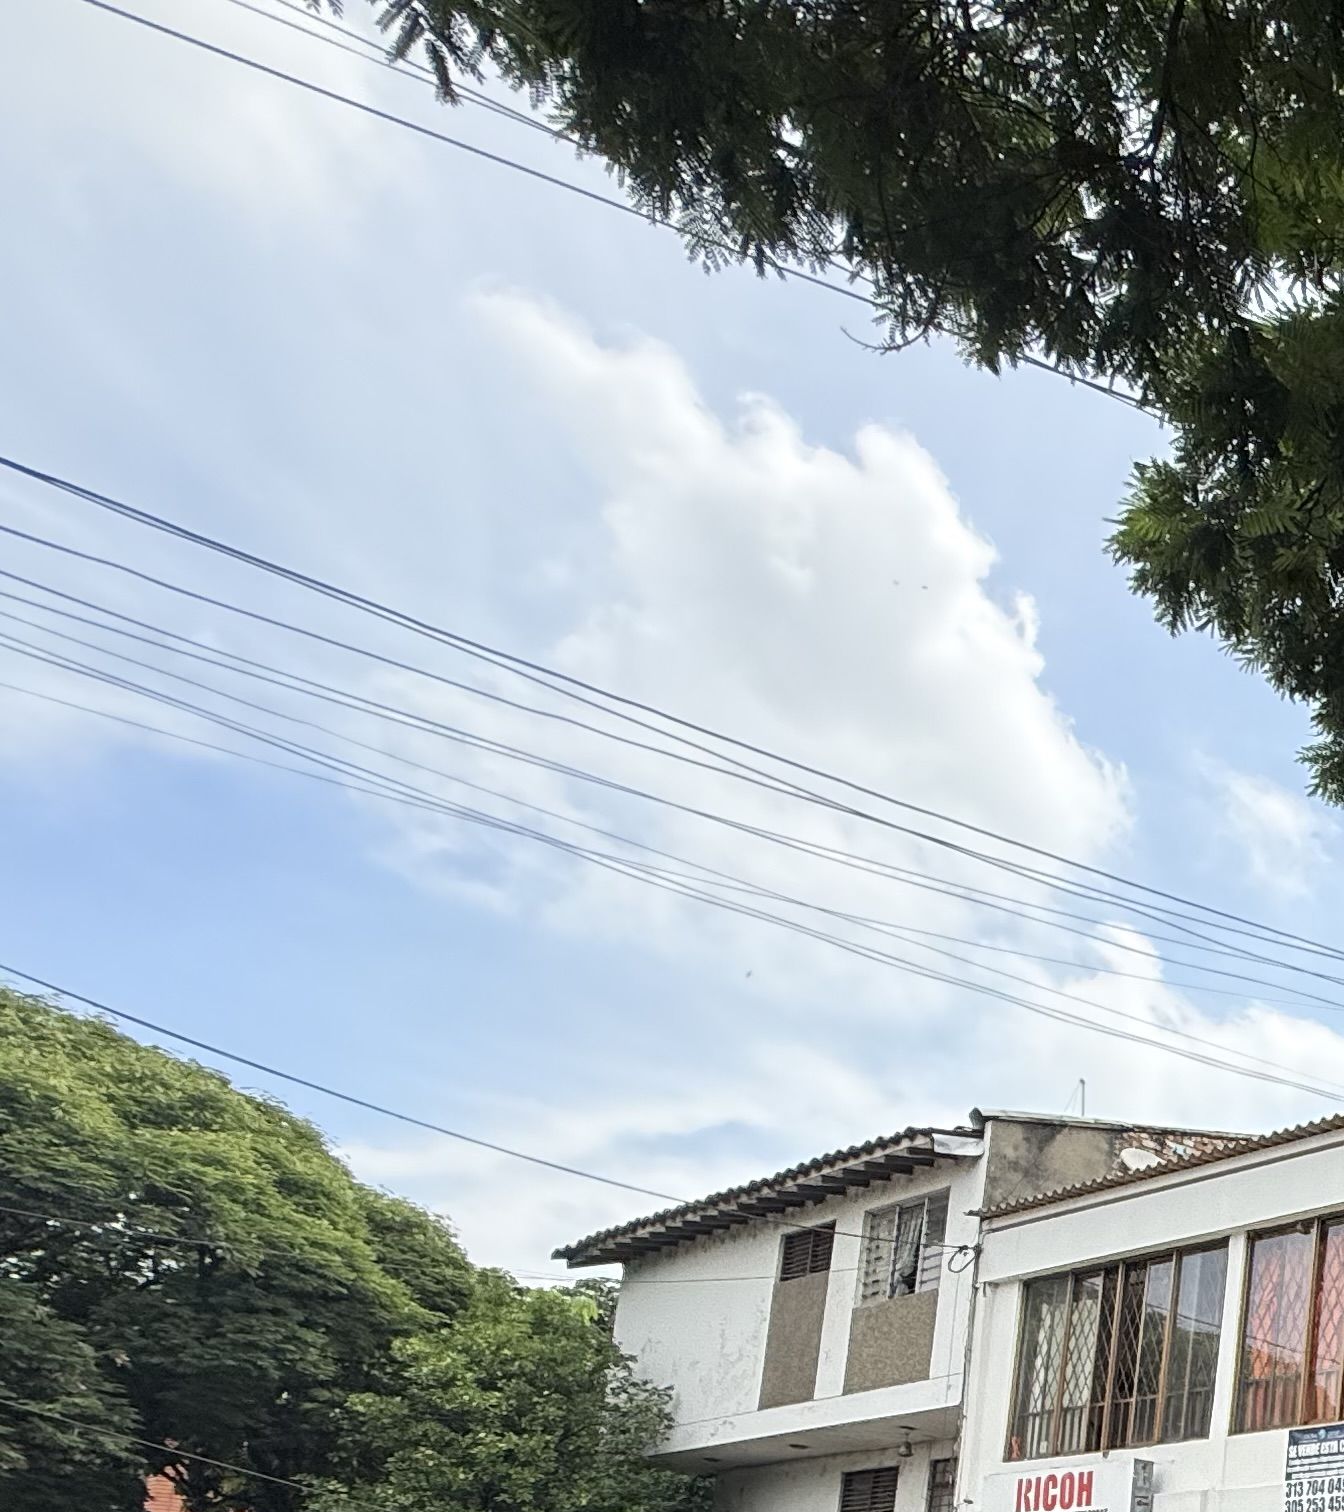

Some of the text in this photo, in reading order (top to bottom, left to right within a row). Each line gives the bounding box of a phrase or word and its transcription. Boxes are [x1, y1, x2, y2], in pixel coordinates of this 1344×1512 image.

[1288, 1444, 1298, 1458] SE
[1015, 1470, 1094, 1512] RICOH
[1286, 1481, 1304, 1498] 313
[1306, 1478, 1325, 1496] 704
